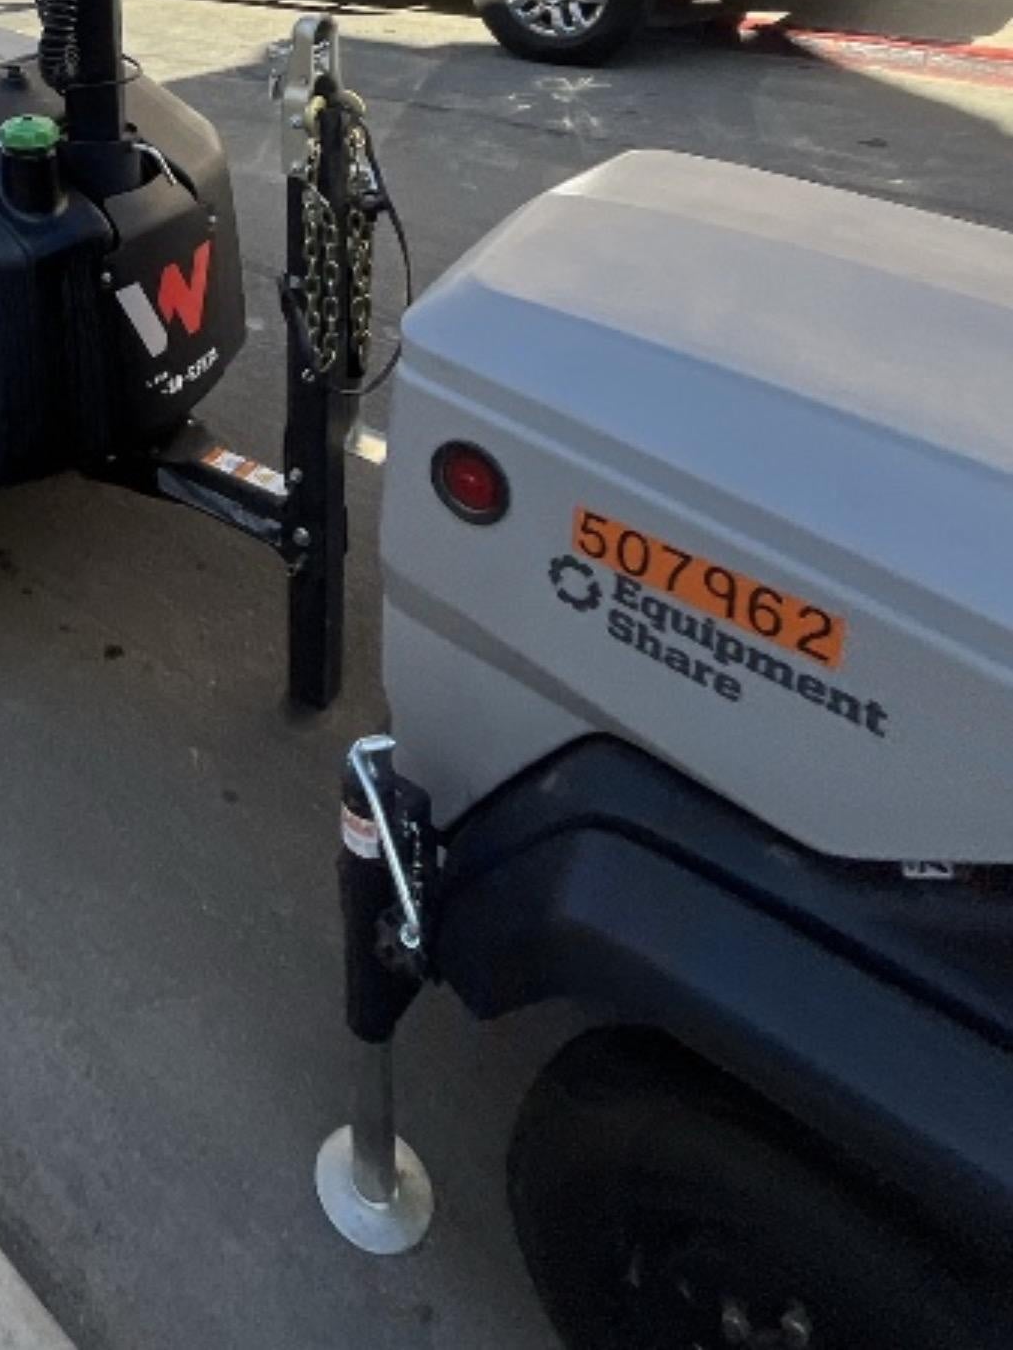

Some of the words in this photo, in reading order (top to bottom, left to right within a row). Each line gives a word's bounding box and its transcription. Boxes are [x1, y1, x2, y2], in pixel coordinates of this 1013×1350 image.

[578, 511, 832, 662] 507962
[607, 609, 743, 702] Share
[612, 573, 889, 738] Equipment
